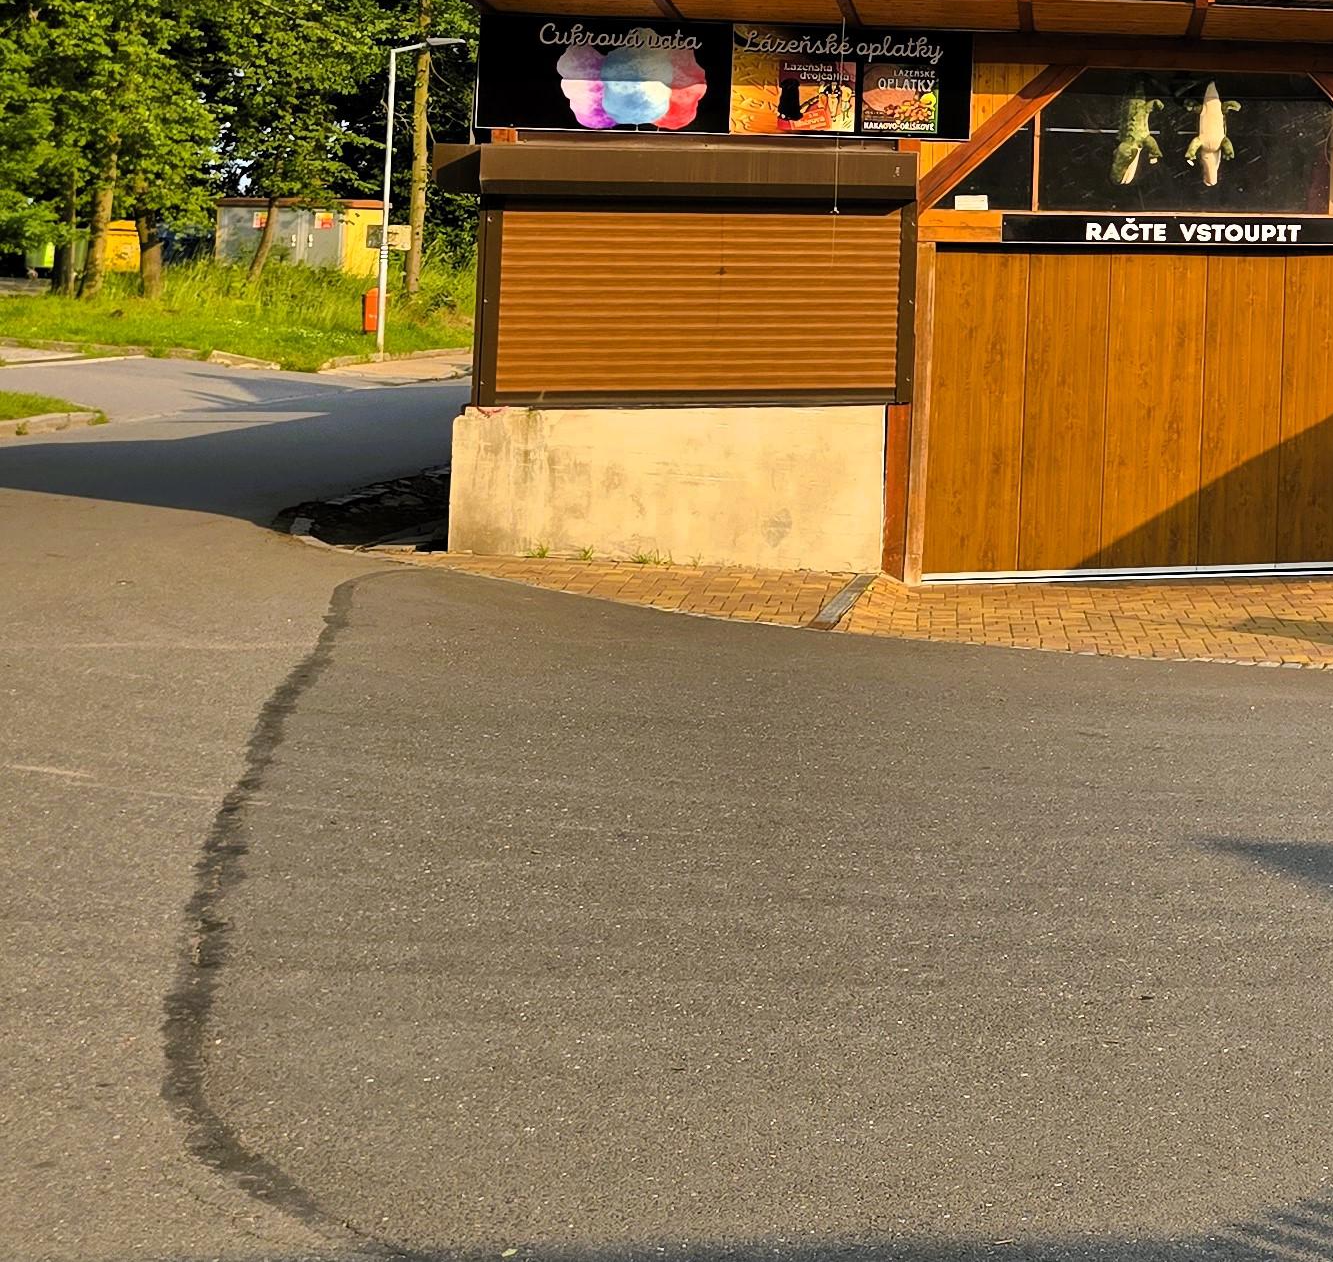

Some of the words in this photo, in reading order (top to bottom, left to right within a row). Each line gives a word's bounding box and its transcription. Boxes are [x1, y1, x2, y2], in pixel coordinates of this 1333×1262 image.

[539, 22, 643, 48] Cukrová
[646, 29, 703, 50] vata
[744, 30, 853, 55] Lázeňské
[856, 36, 944, 64] oplatky
[877, 77, 936, 92] OPLATKY
[1085, 217, 1168, 241] RAČTE
[1179, 223, 1303, 242] VSTOUPIT
